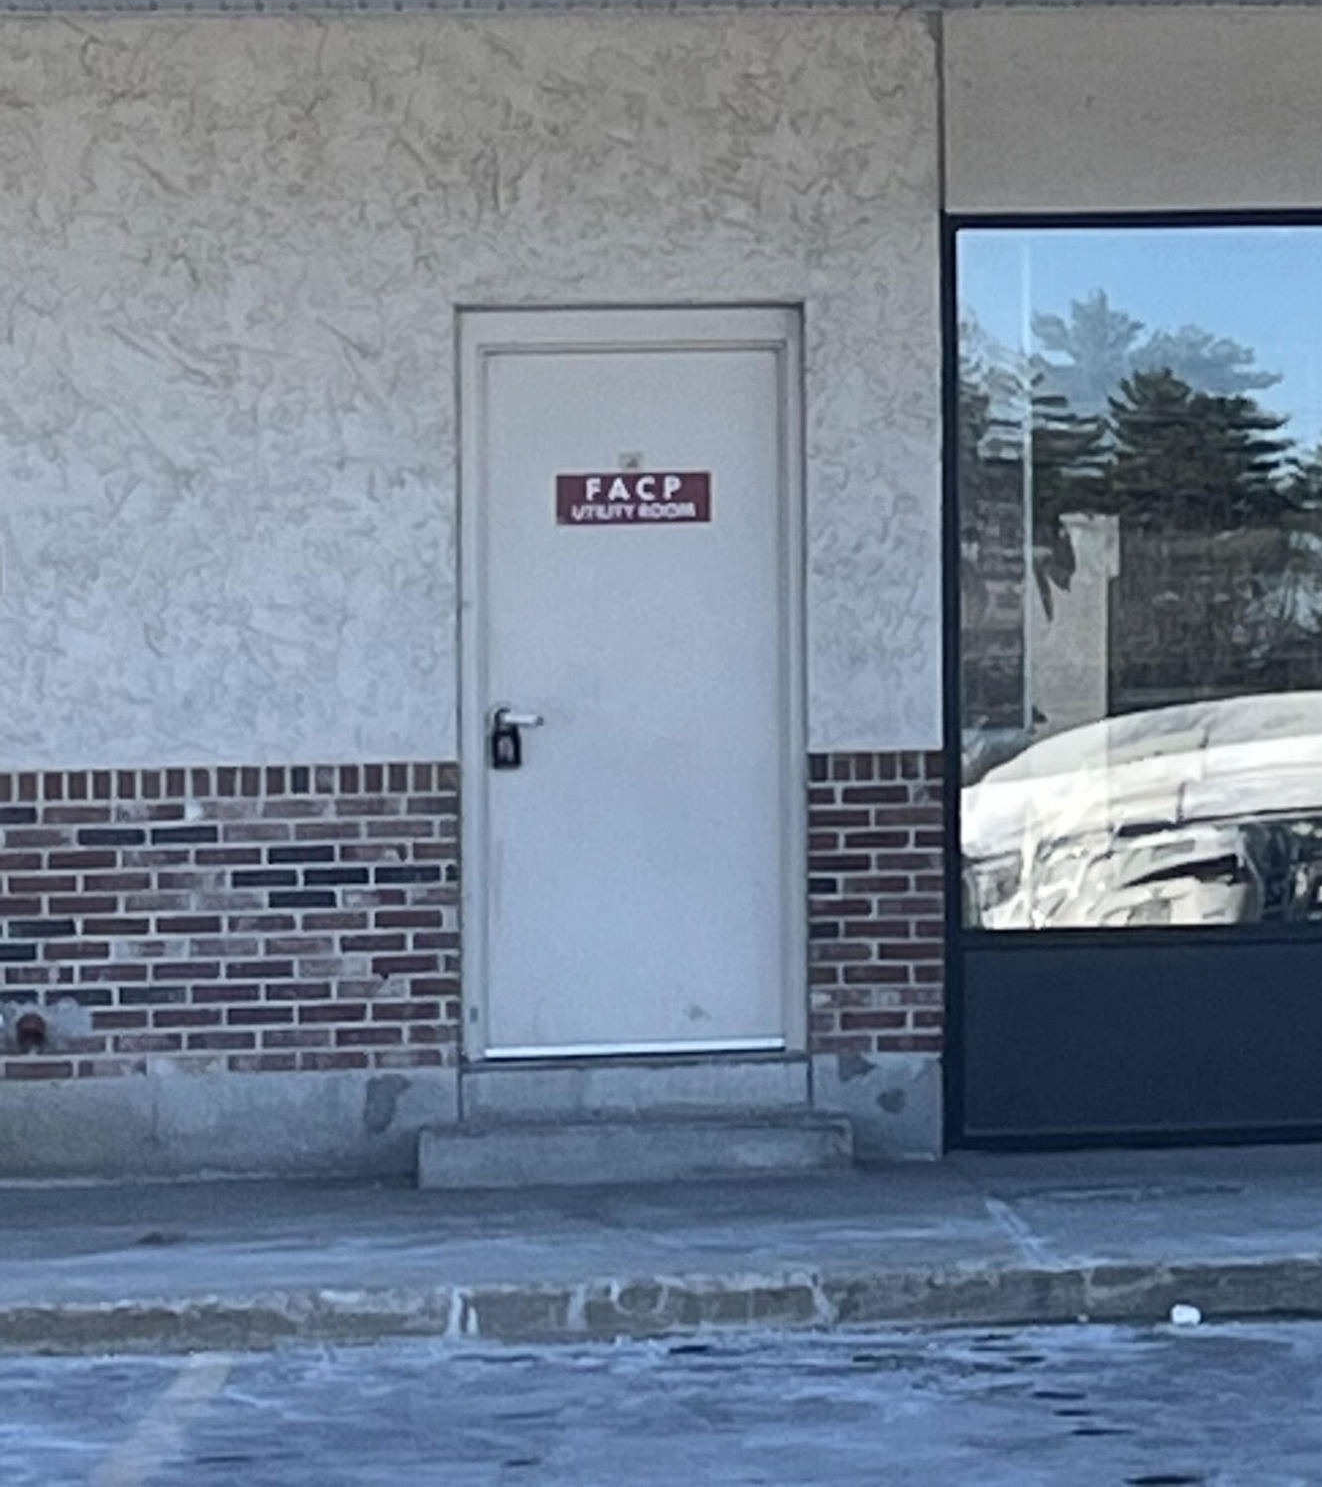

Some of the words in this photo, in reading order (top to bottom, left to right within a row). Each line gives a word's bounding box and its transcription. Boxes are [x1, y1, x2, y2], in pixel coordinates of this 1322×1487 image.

[585, 476, 682, 501] FACP
[571, 504, 635, 521] UTILITY
[638, 502, 697, 518] ROOM
